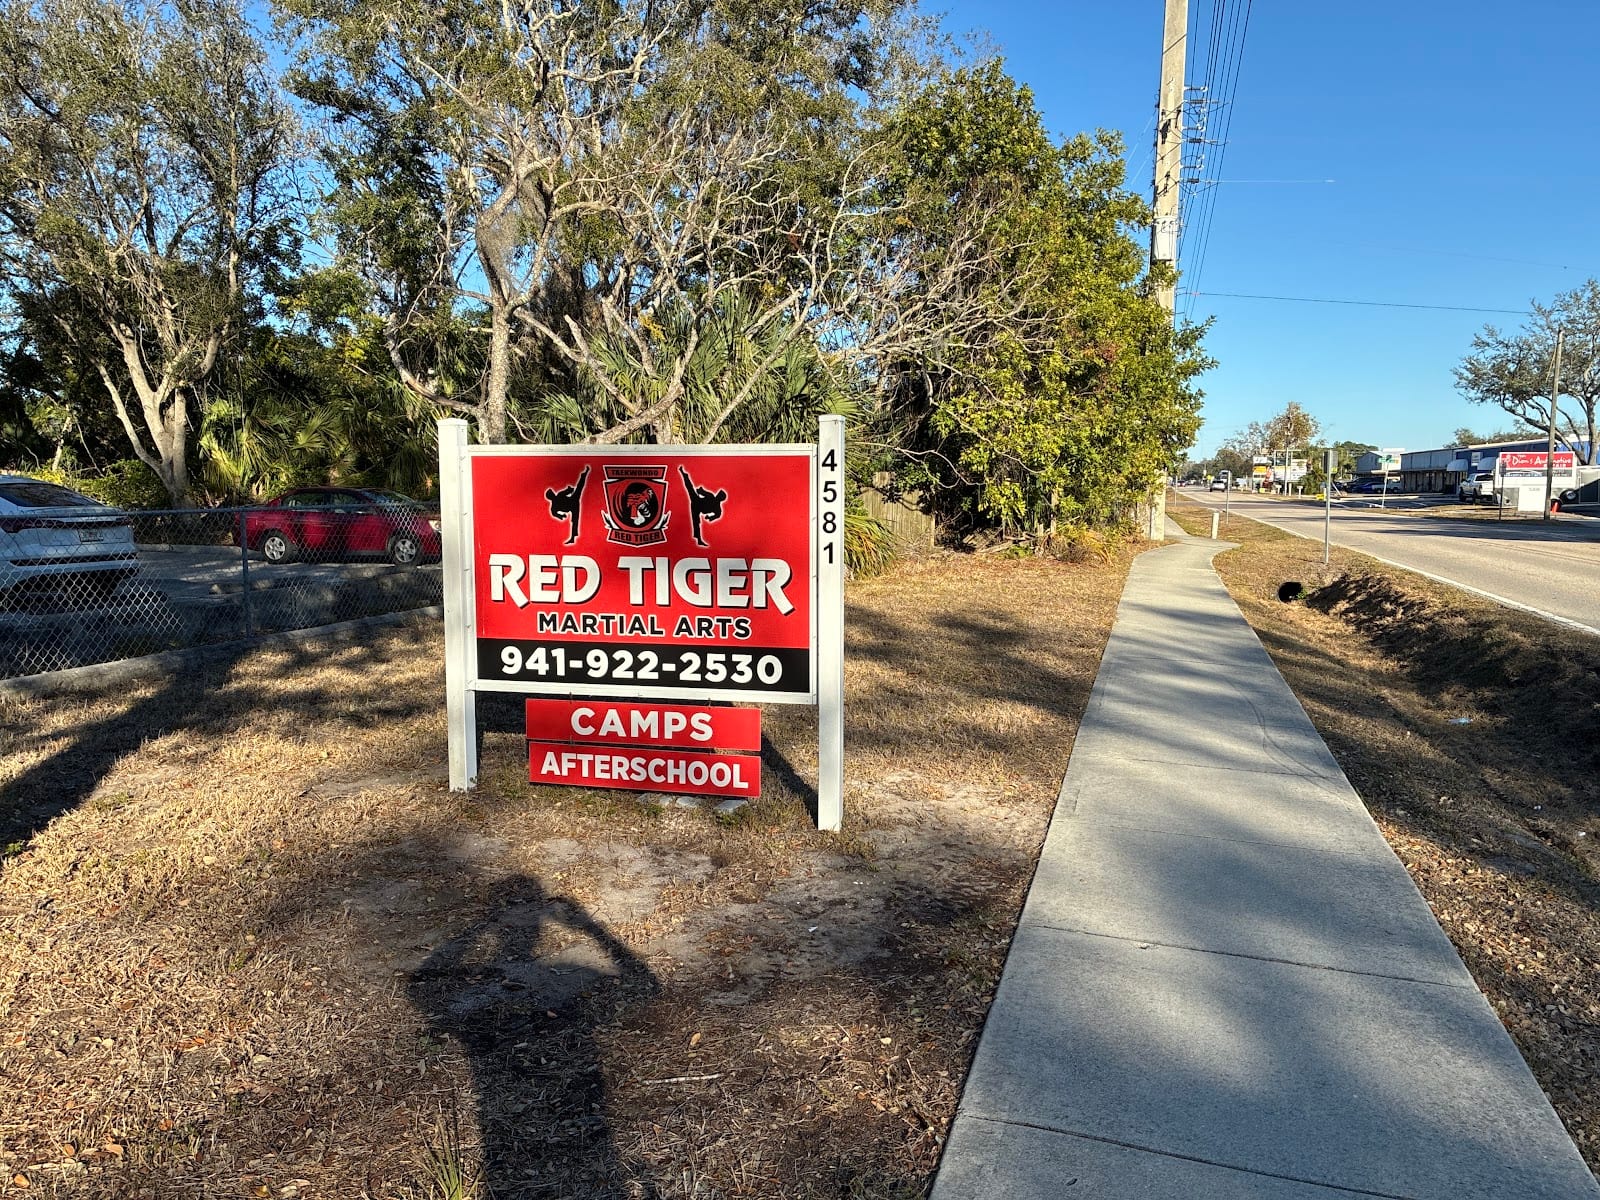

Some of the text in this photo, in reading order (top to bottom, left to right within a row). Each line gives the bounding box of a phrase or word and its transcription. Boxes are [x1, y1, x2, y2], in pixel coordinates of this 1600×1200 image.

[821, 448, 838, 564] 4581
[614, 530, 660, 542] RED TIGER
[488, 553, 795, 615] RED TIGER
[537, 612, 752, 639] MARTIAL ARTS
[500, 645, 783, 685] 941-922-2530
[570, 707, 713, 741] CAMPS
[540, 751, 749, 789] AFTERSCHOOL
